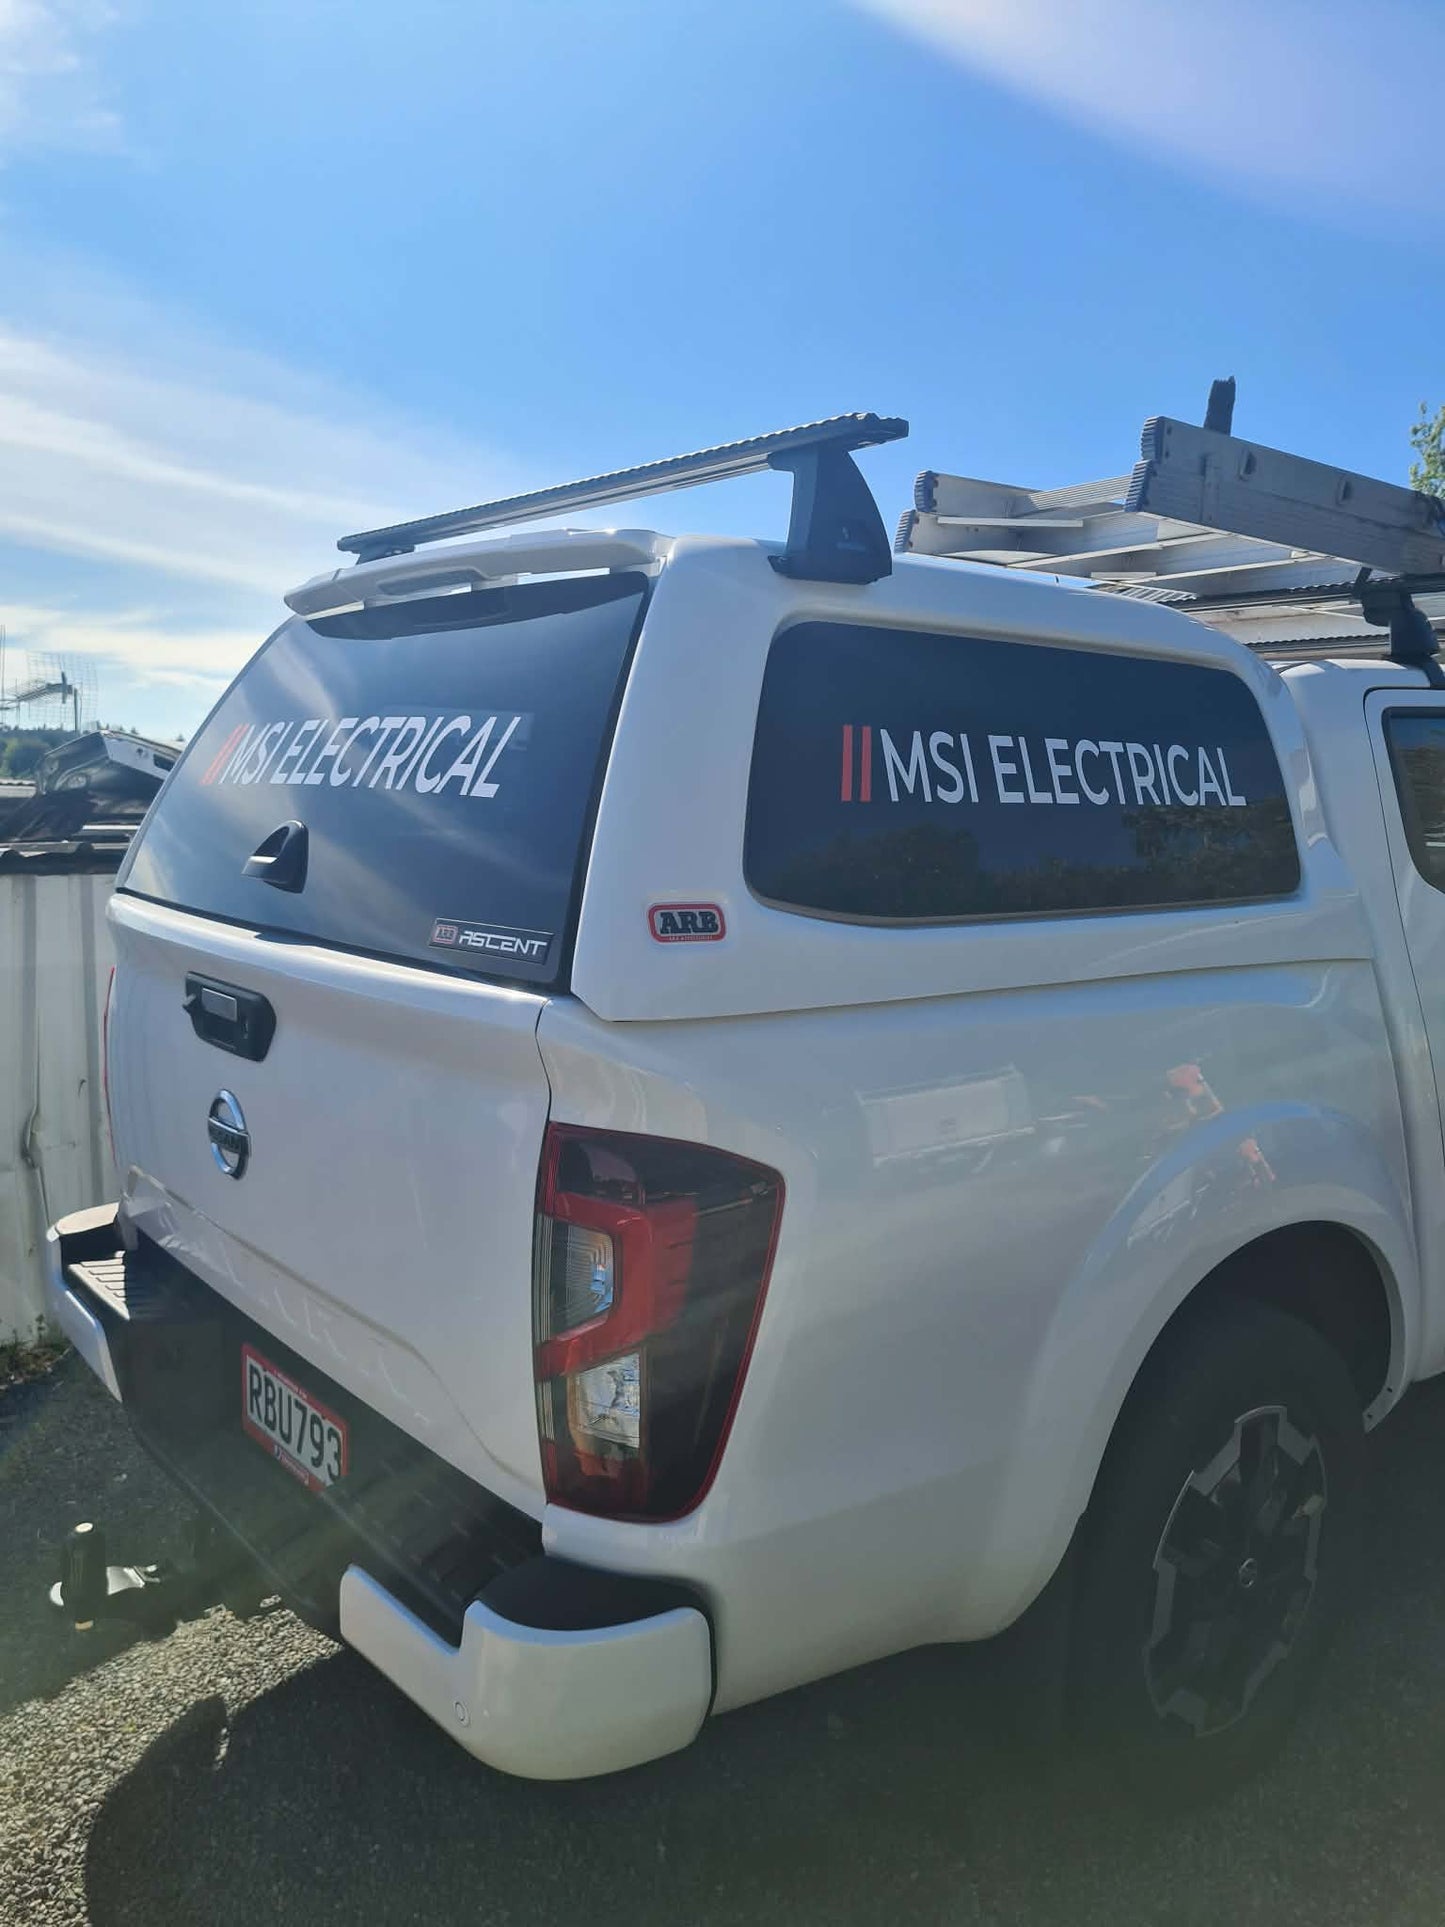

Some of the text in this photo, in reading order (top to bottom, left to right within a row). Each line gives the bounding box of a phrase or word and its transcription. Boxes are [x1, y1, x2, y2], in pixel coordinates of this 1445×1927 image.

[218, 715, 521, 799] MSI ELECTRICAL
[879, 728, 1247, 807] MSI ELECTRICAL
[458, 930, 548, 956] ASCENT
[659, 911, 719, 934] ARB
[248, 1363, 343, 1484] RBU793
